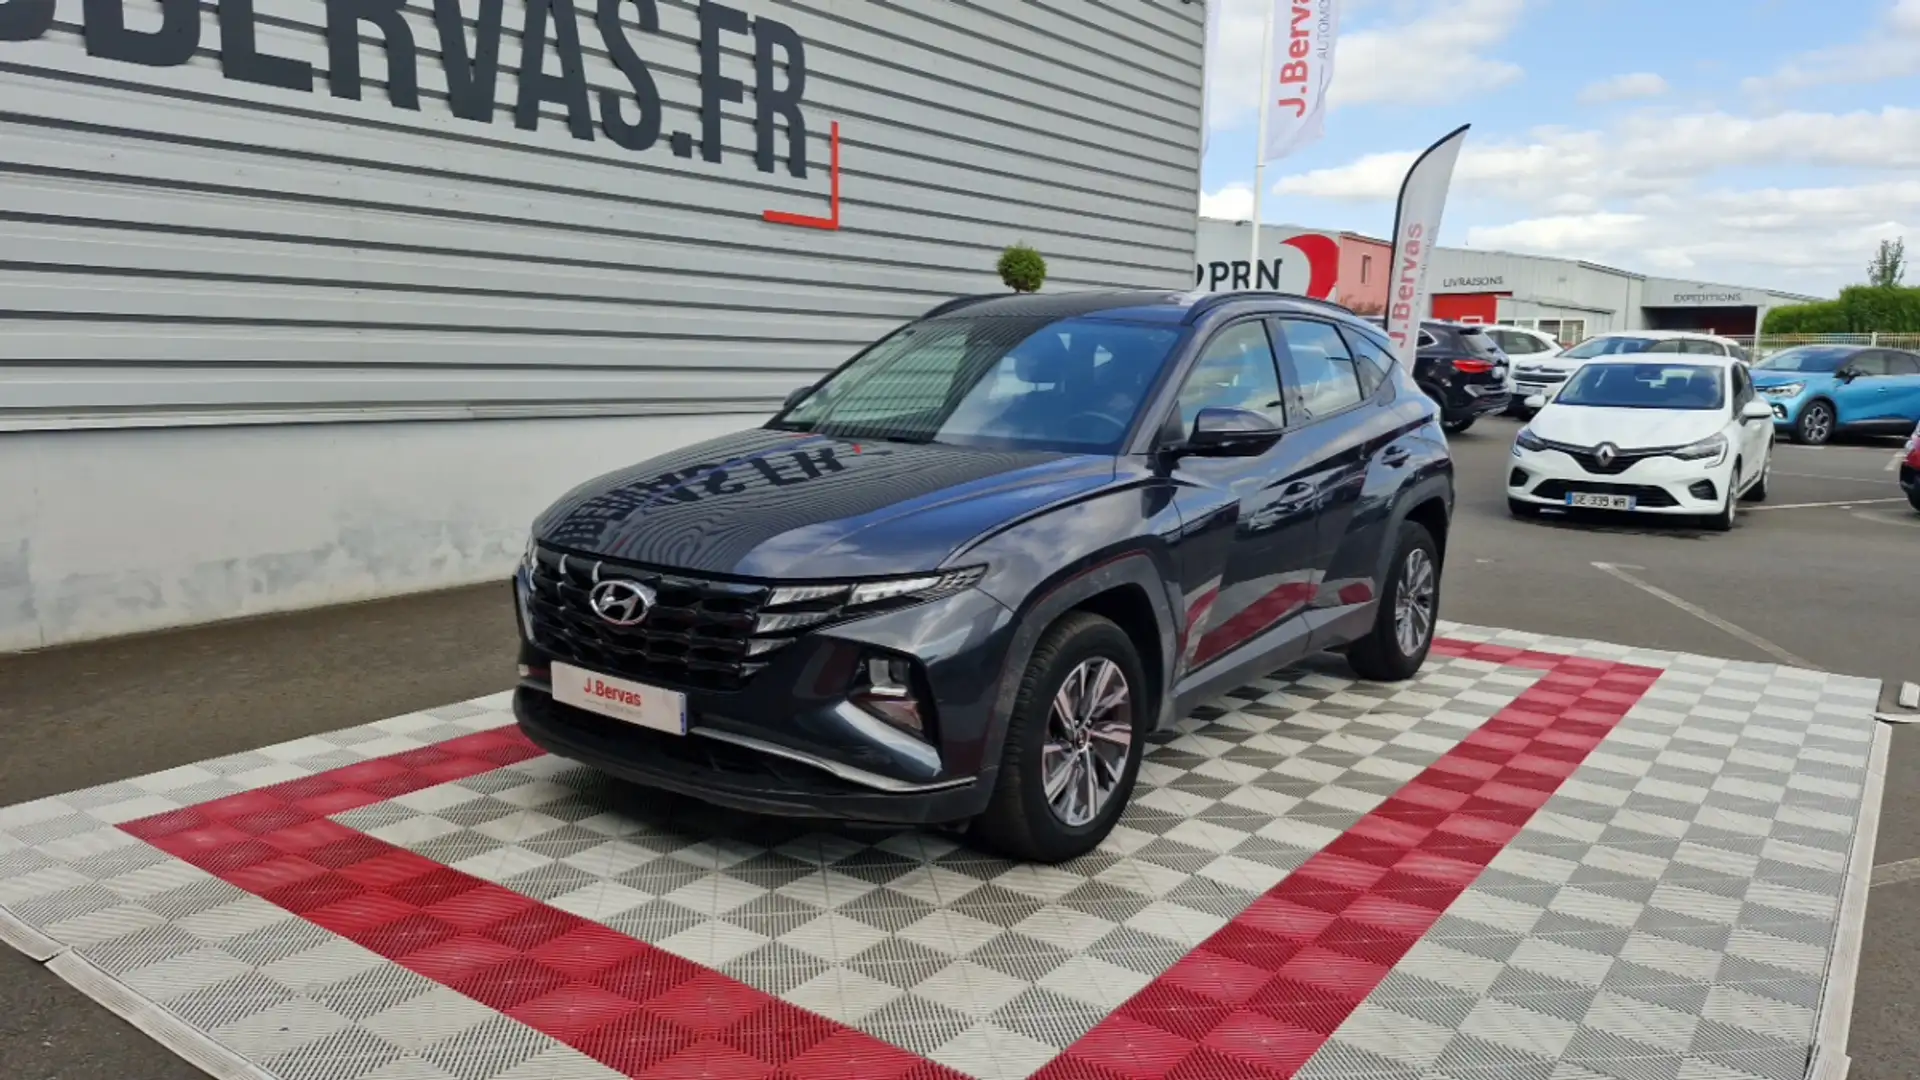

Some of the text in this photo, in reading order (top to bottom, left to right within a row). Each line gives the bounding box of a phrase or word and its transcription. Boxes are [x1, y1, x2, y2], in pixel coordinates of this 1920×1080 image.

[1278, 0, 1311, 118] J.Berv
[1389, 222, 1423, 348] J.Bervas
[1443, 276, 1503, 287] LIVRAISONS
[583, 677, 641, 707] J.Bervas
